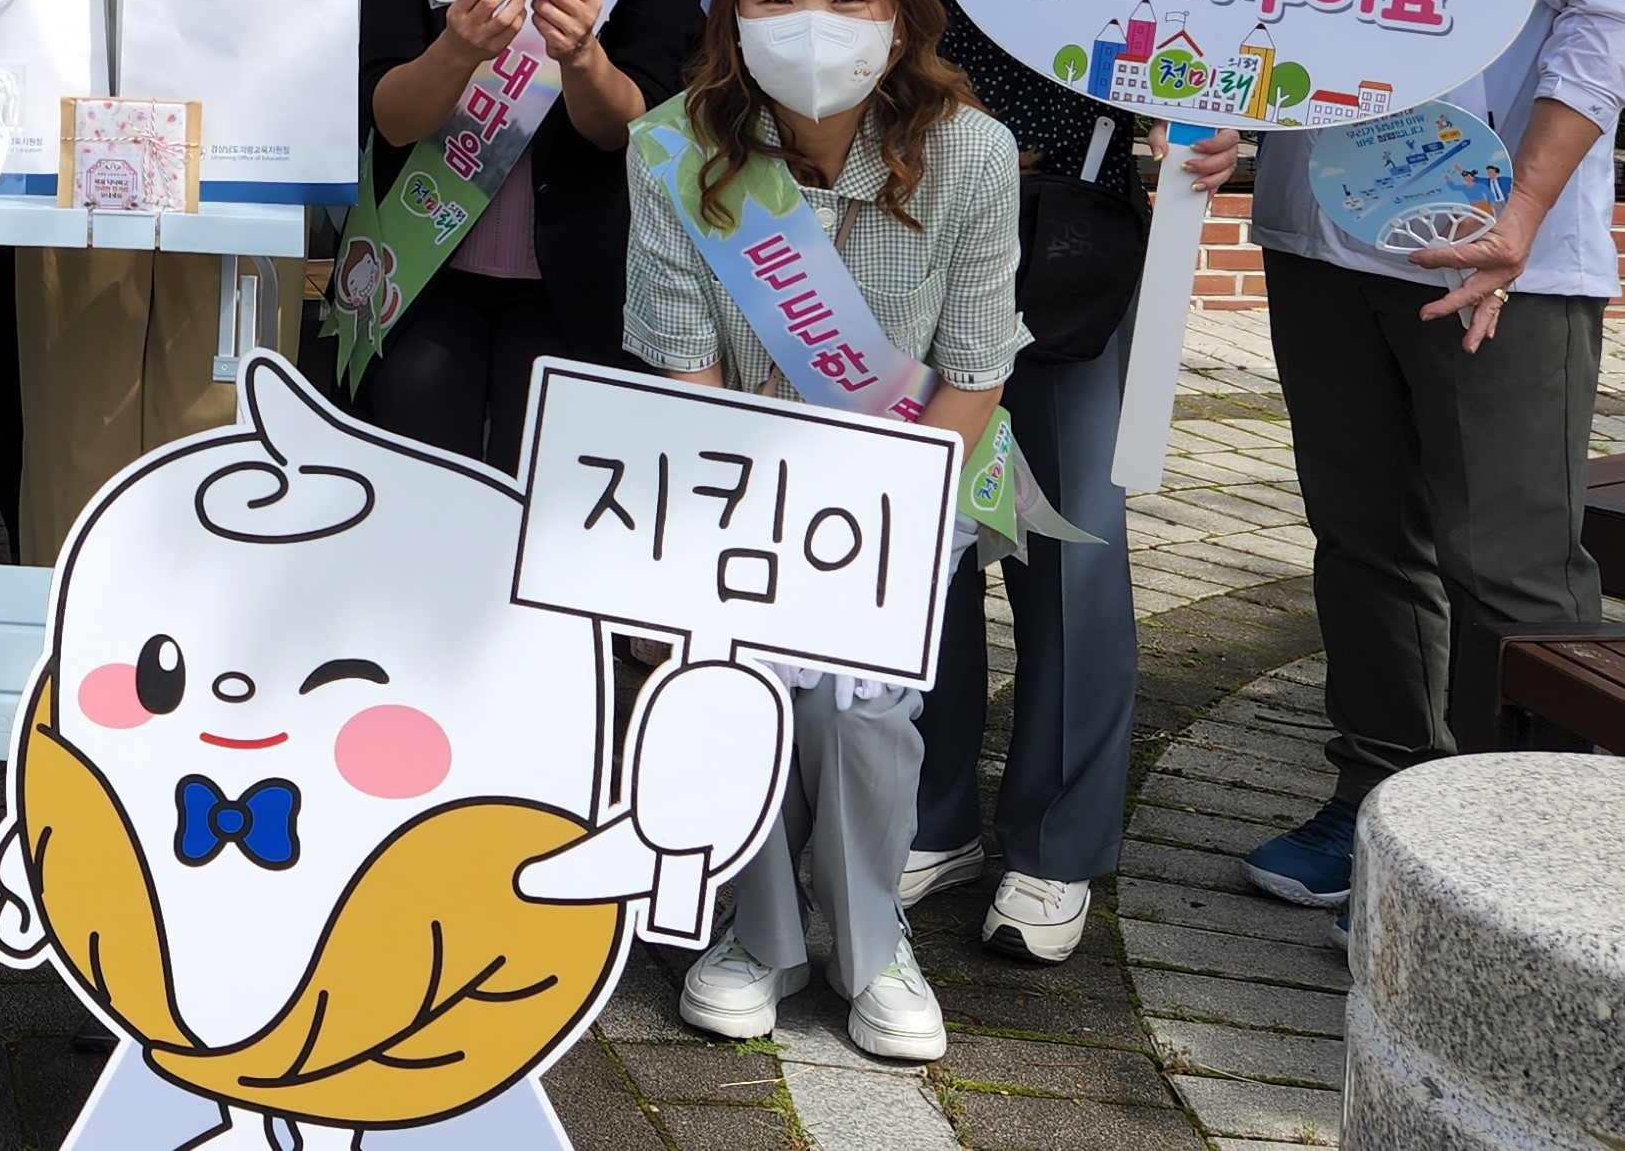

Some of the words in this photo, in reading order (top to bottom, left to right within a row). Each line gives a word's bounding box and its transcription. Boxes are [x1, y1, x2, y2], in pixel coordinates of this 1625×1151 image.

[1160, 58, 1255, 111] 청미래
[744, 234, 879, 393] 든든한
[578, 451, 892, 609] 지킴이
